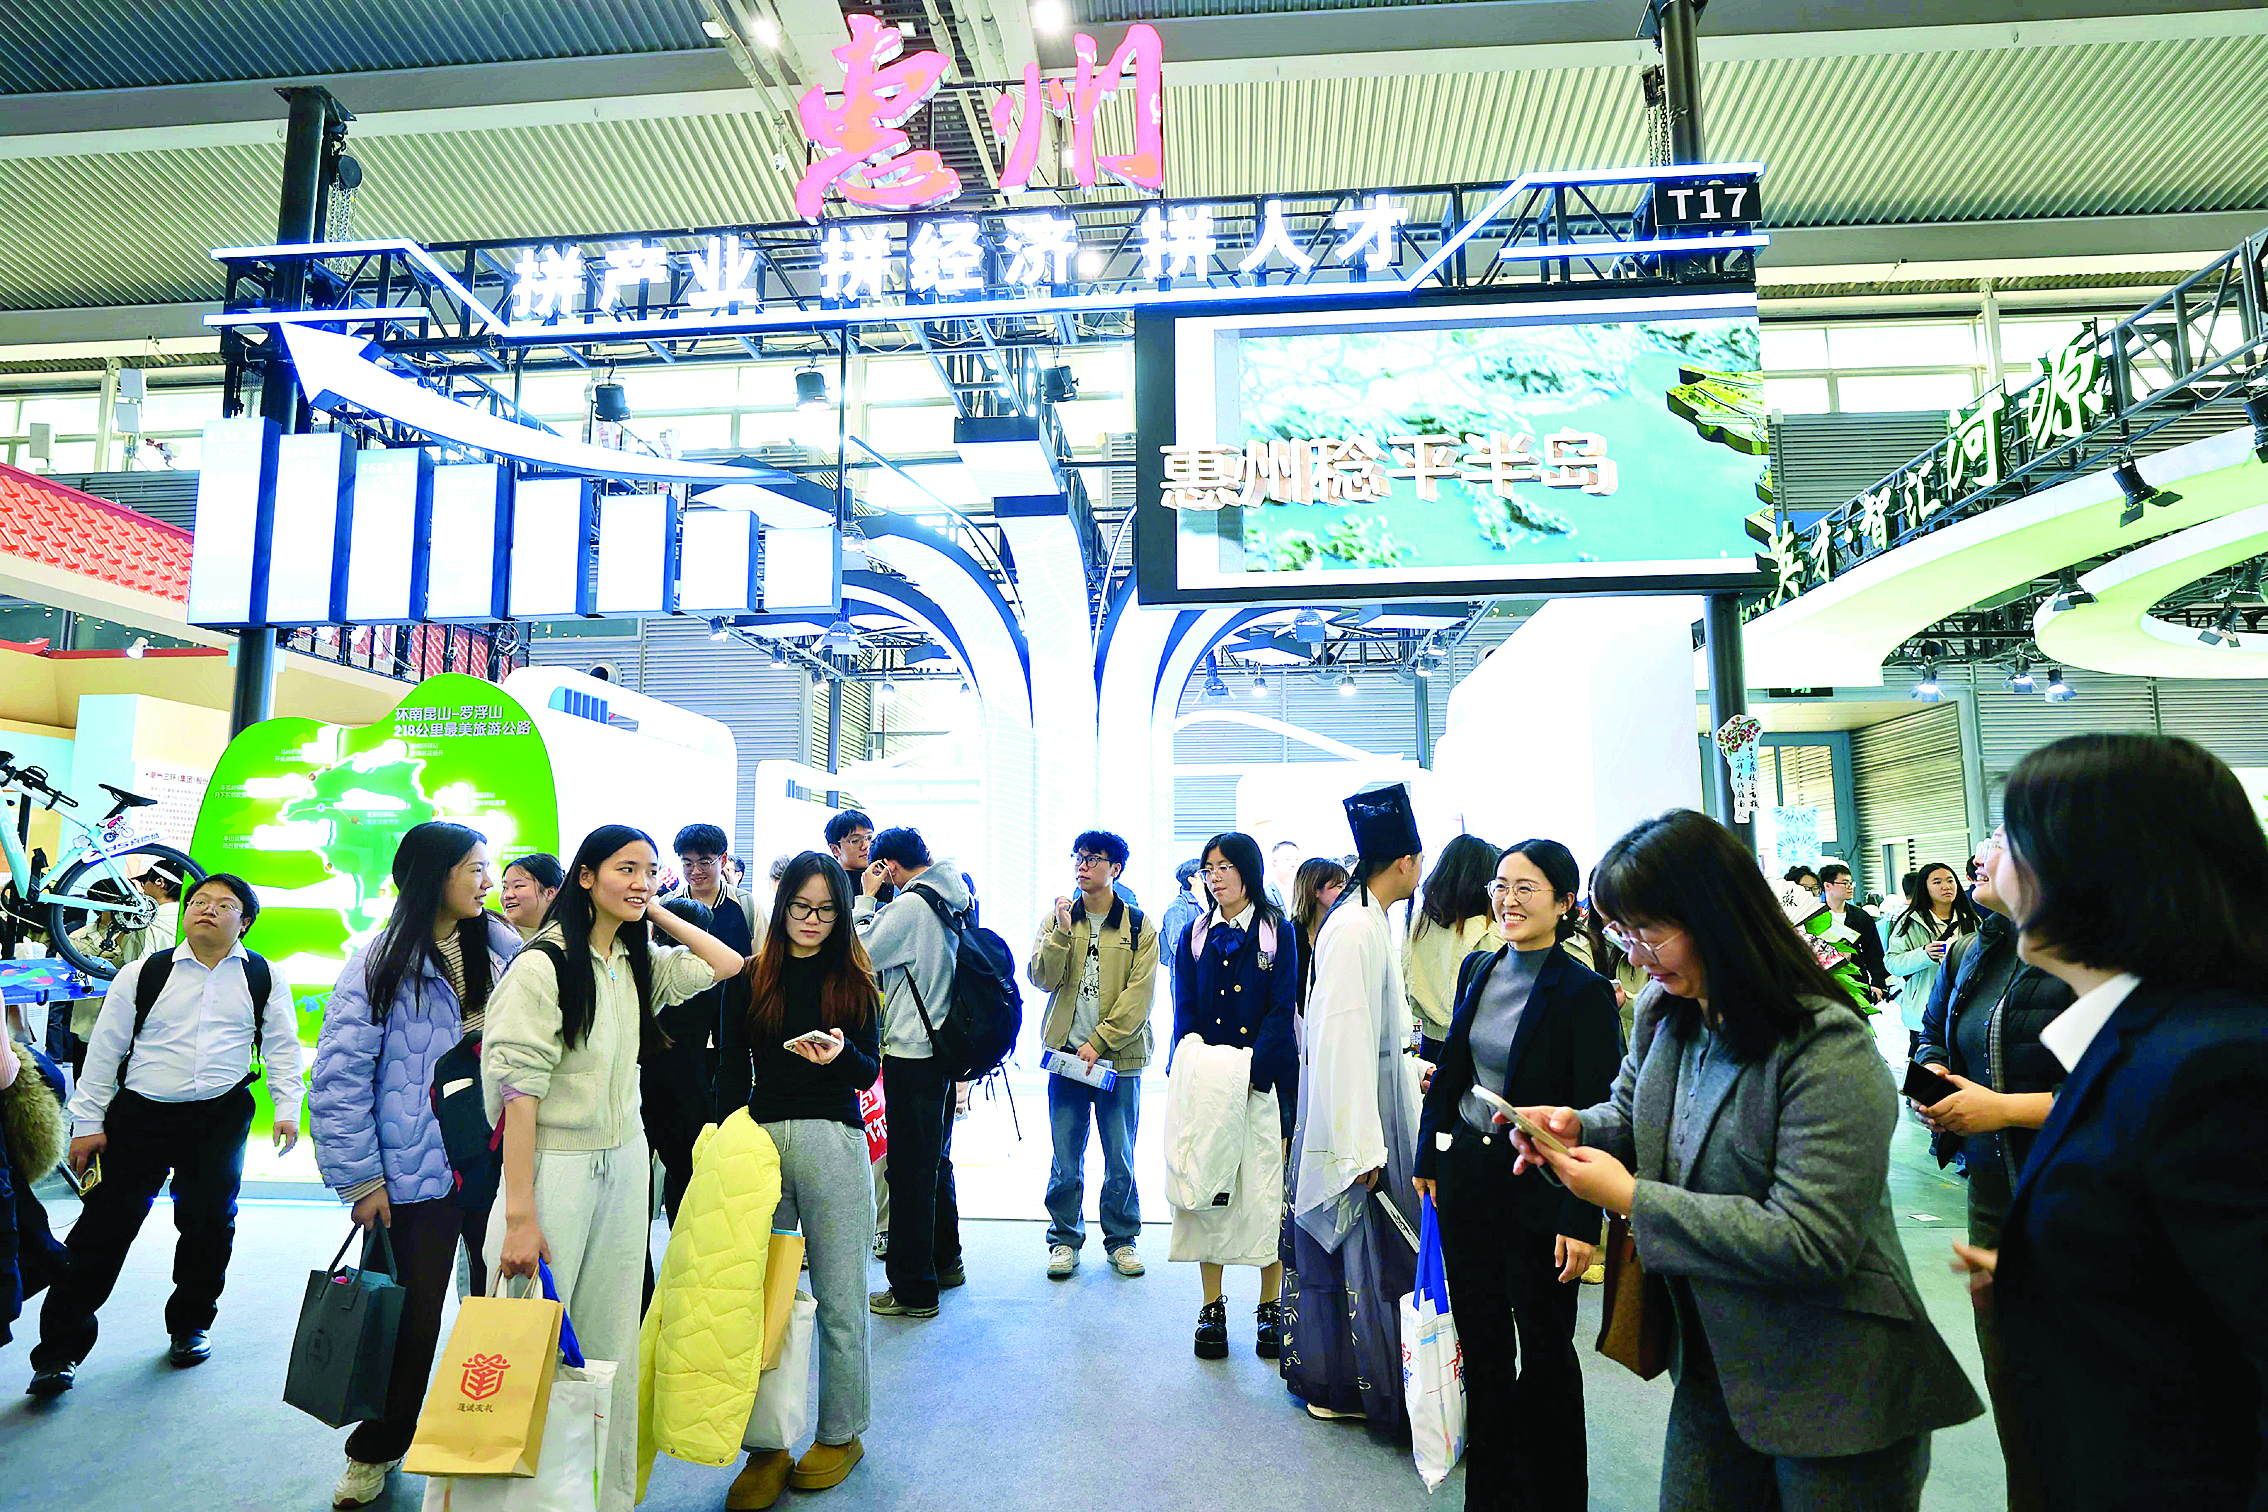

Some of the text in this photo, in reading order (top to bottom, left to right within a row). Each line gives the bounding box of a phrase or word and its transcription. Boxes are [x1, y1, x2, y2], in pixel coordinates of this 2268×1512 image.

[795, 14, 1163, 224] 惠州
[1667, 187, 1748, 220] T17
[513, 194, 1409, 319] 拼产业 拼经济 拼人才
[1159, 426, 1618, 512] 惠州稔平半岛
[393, 720, 532, 738] 218公里最美旅游公路
